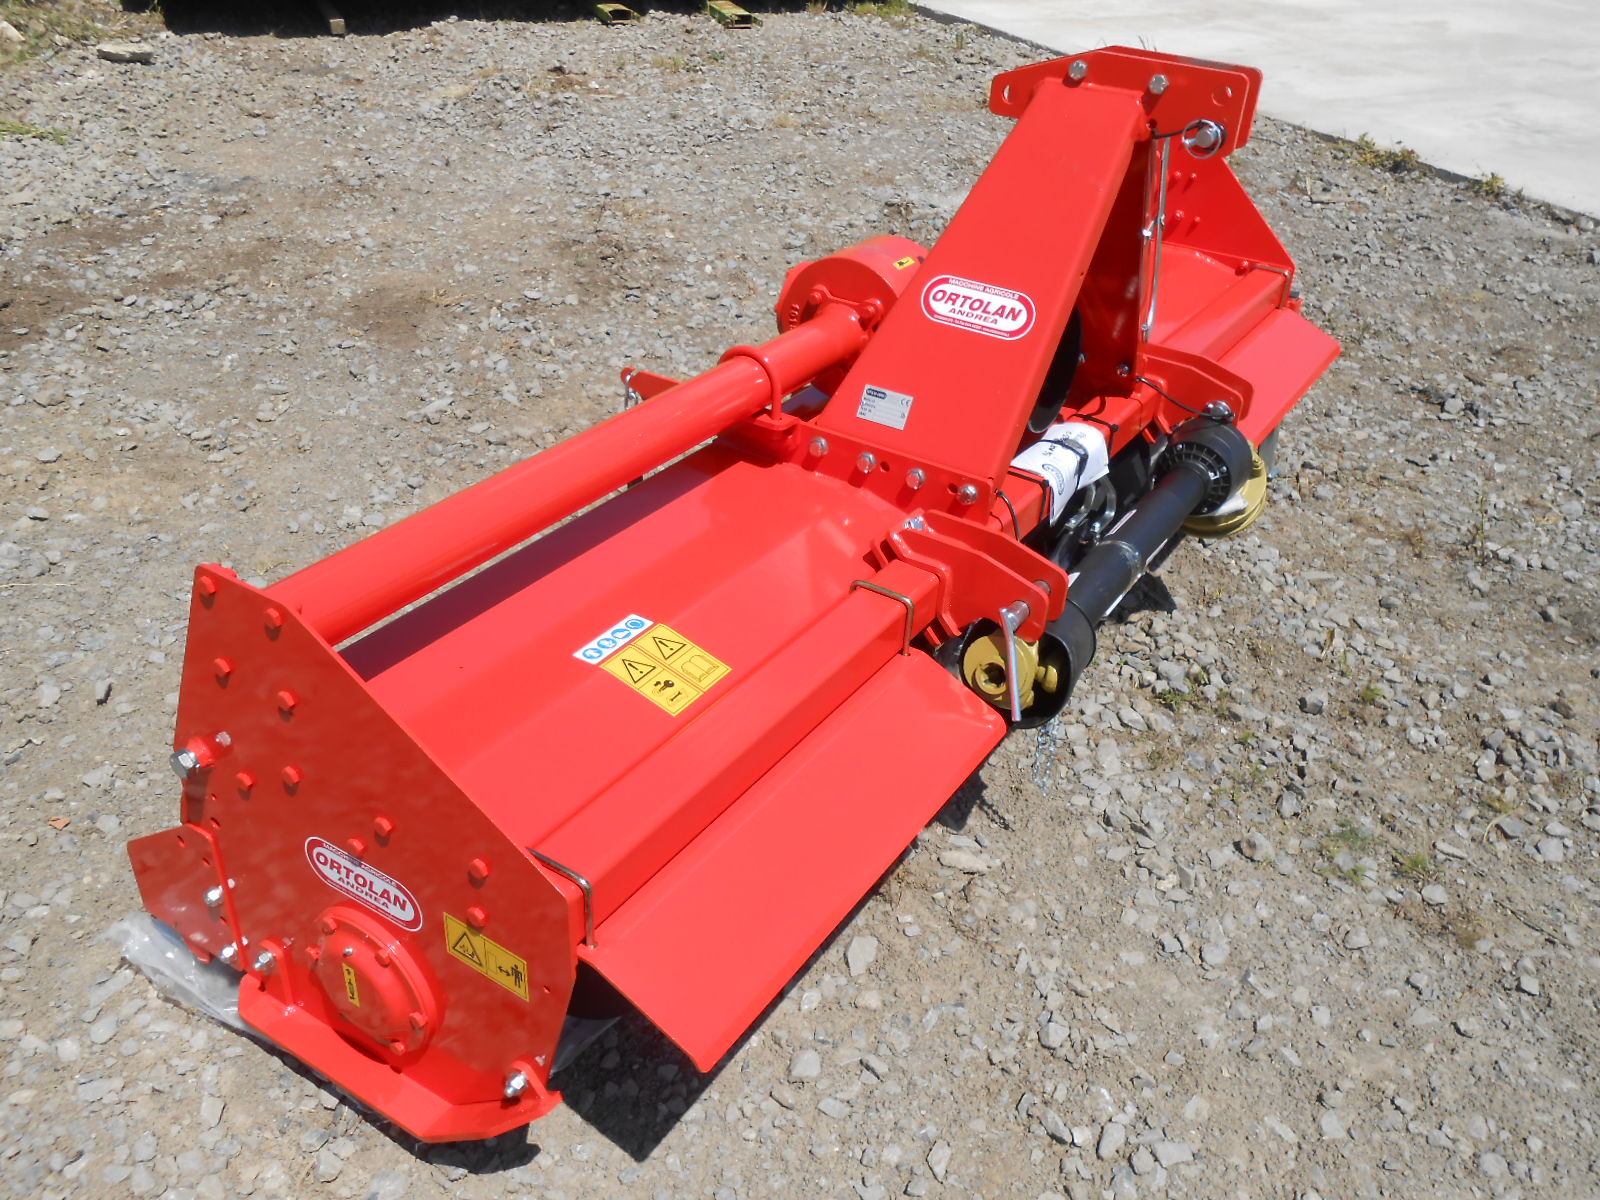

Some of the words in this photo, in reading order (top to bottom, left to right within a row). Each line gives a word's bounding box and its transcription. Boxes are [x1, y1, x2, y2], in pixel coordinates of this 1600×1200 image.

[932, 289, 1023, 322] ORTOLAN
[948, 308, 999, 325] ANDREA
[315, 851, 408, 912] ORTOLAN
[337, 876, 390, 909] ANDREA
